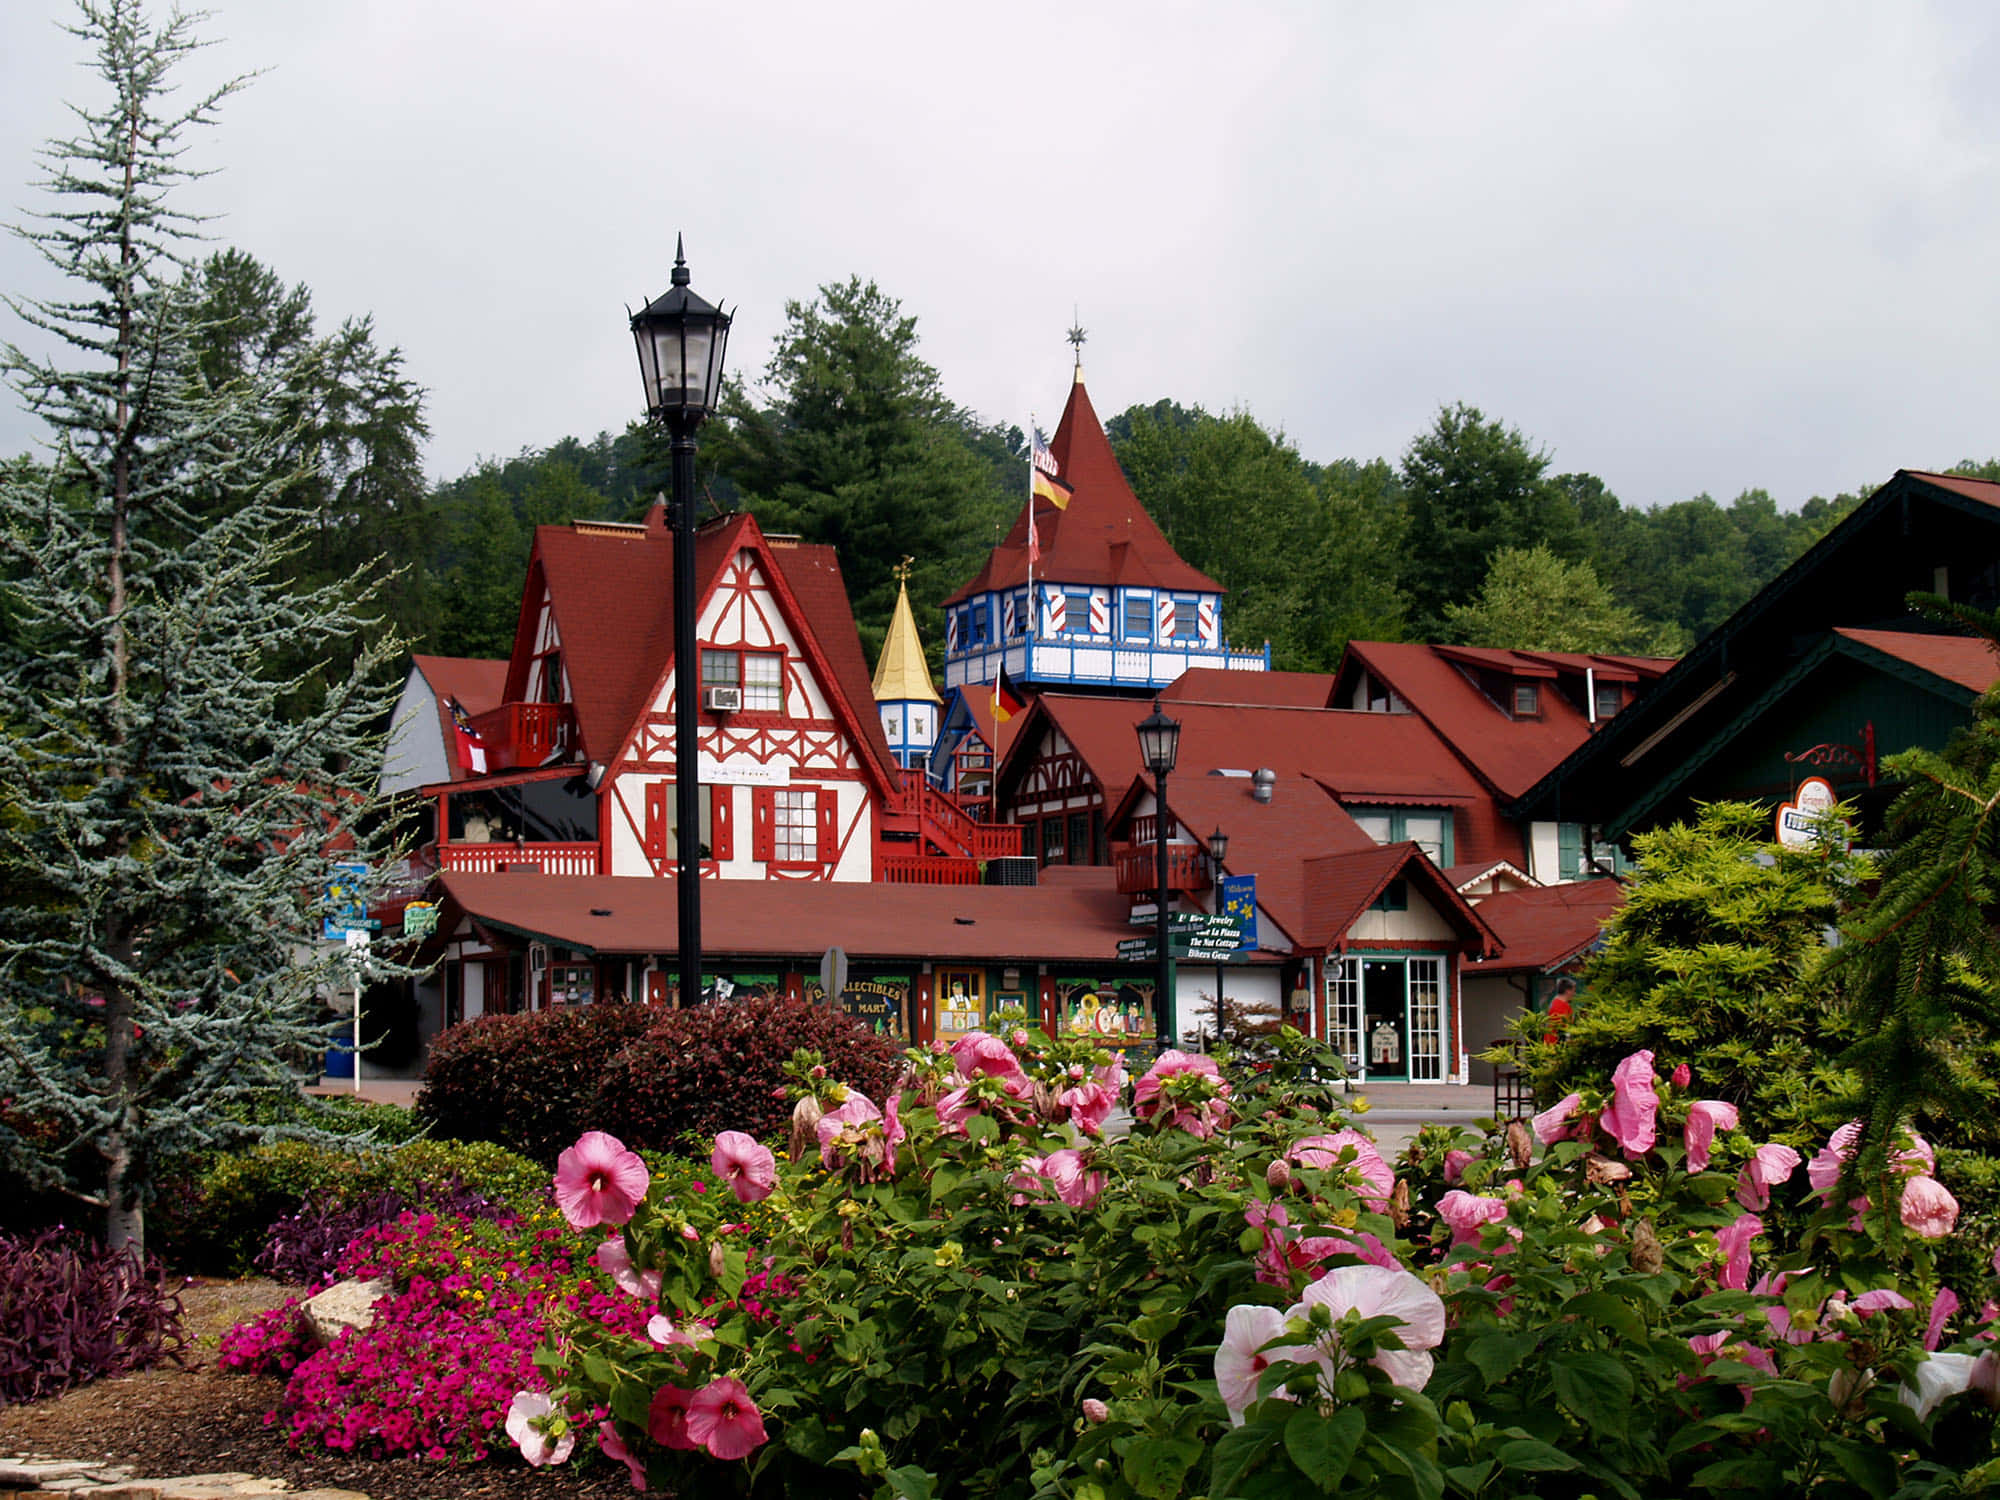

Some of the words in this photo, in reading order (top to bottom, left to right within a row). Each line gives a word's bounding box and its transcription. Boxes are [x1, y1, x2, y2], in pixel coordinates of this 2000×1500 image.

[1207, 915, 1235, 927] Jewelry
[1190, 937, 1202, 946] The
[1203, 938, 1215, 947] Nut
[1215, 939, 1240, 949] Cottage
[1211, 950, 1231, 961] Gear
[843, 982, 901, 1000] LLECTIBLES
[858, 1004, 886, 1014] MART
